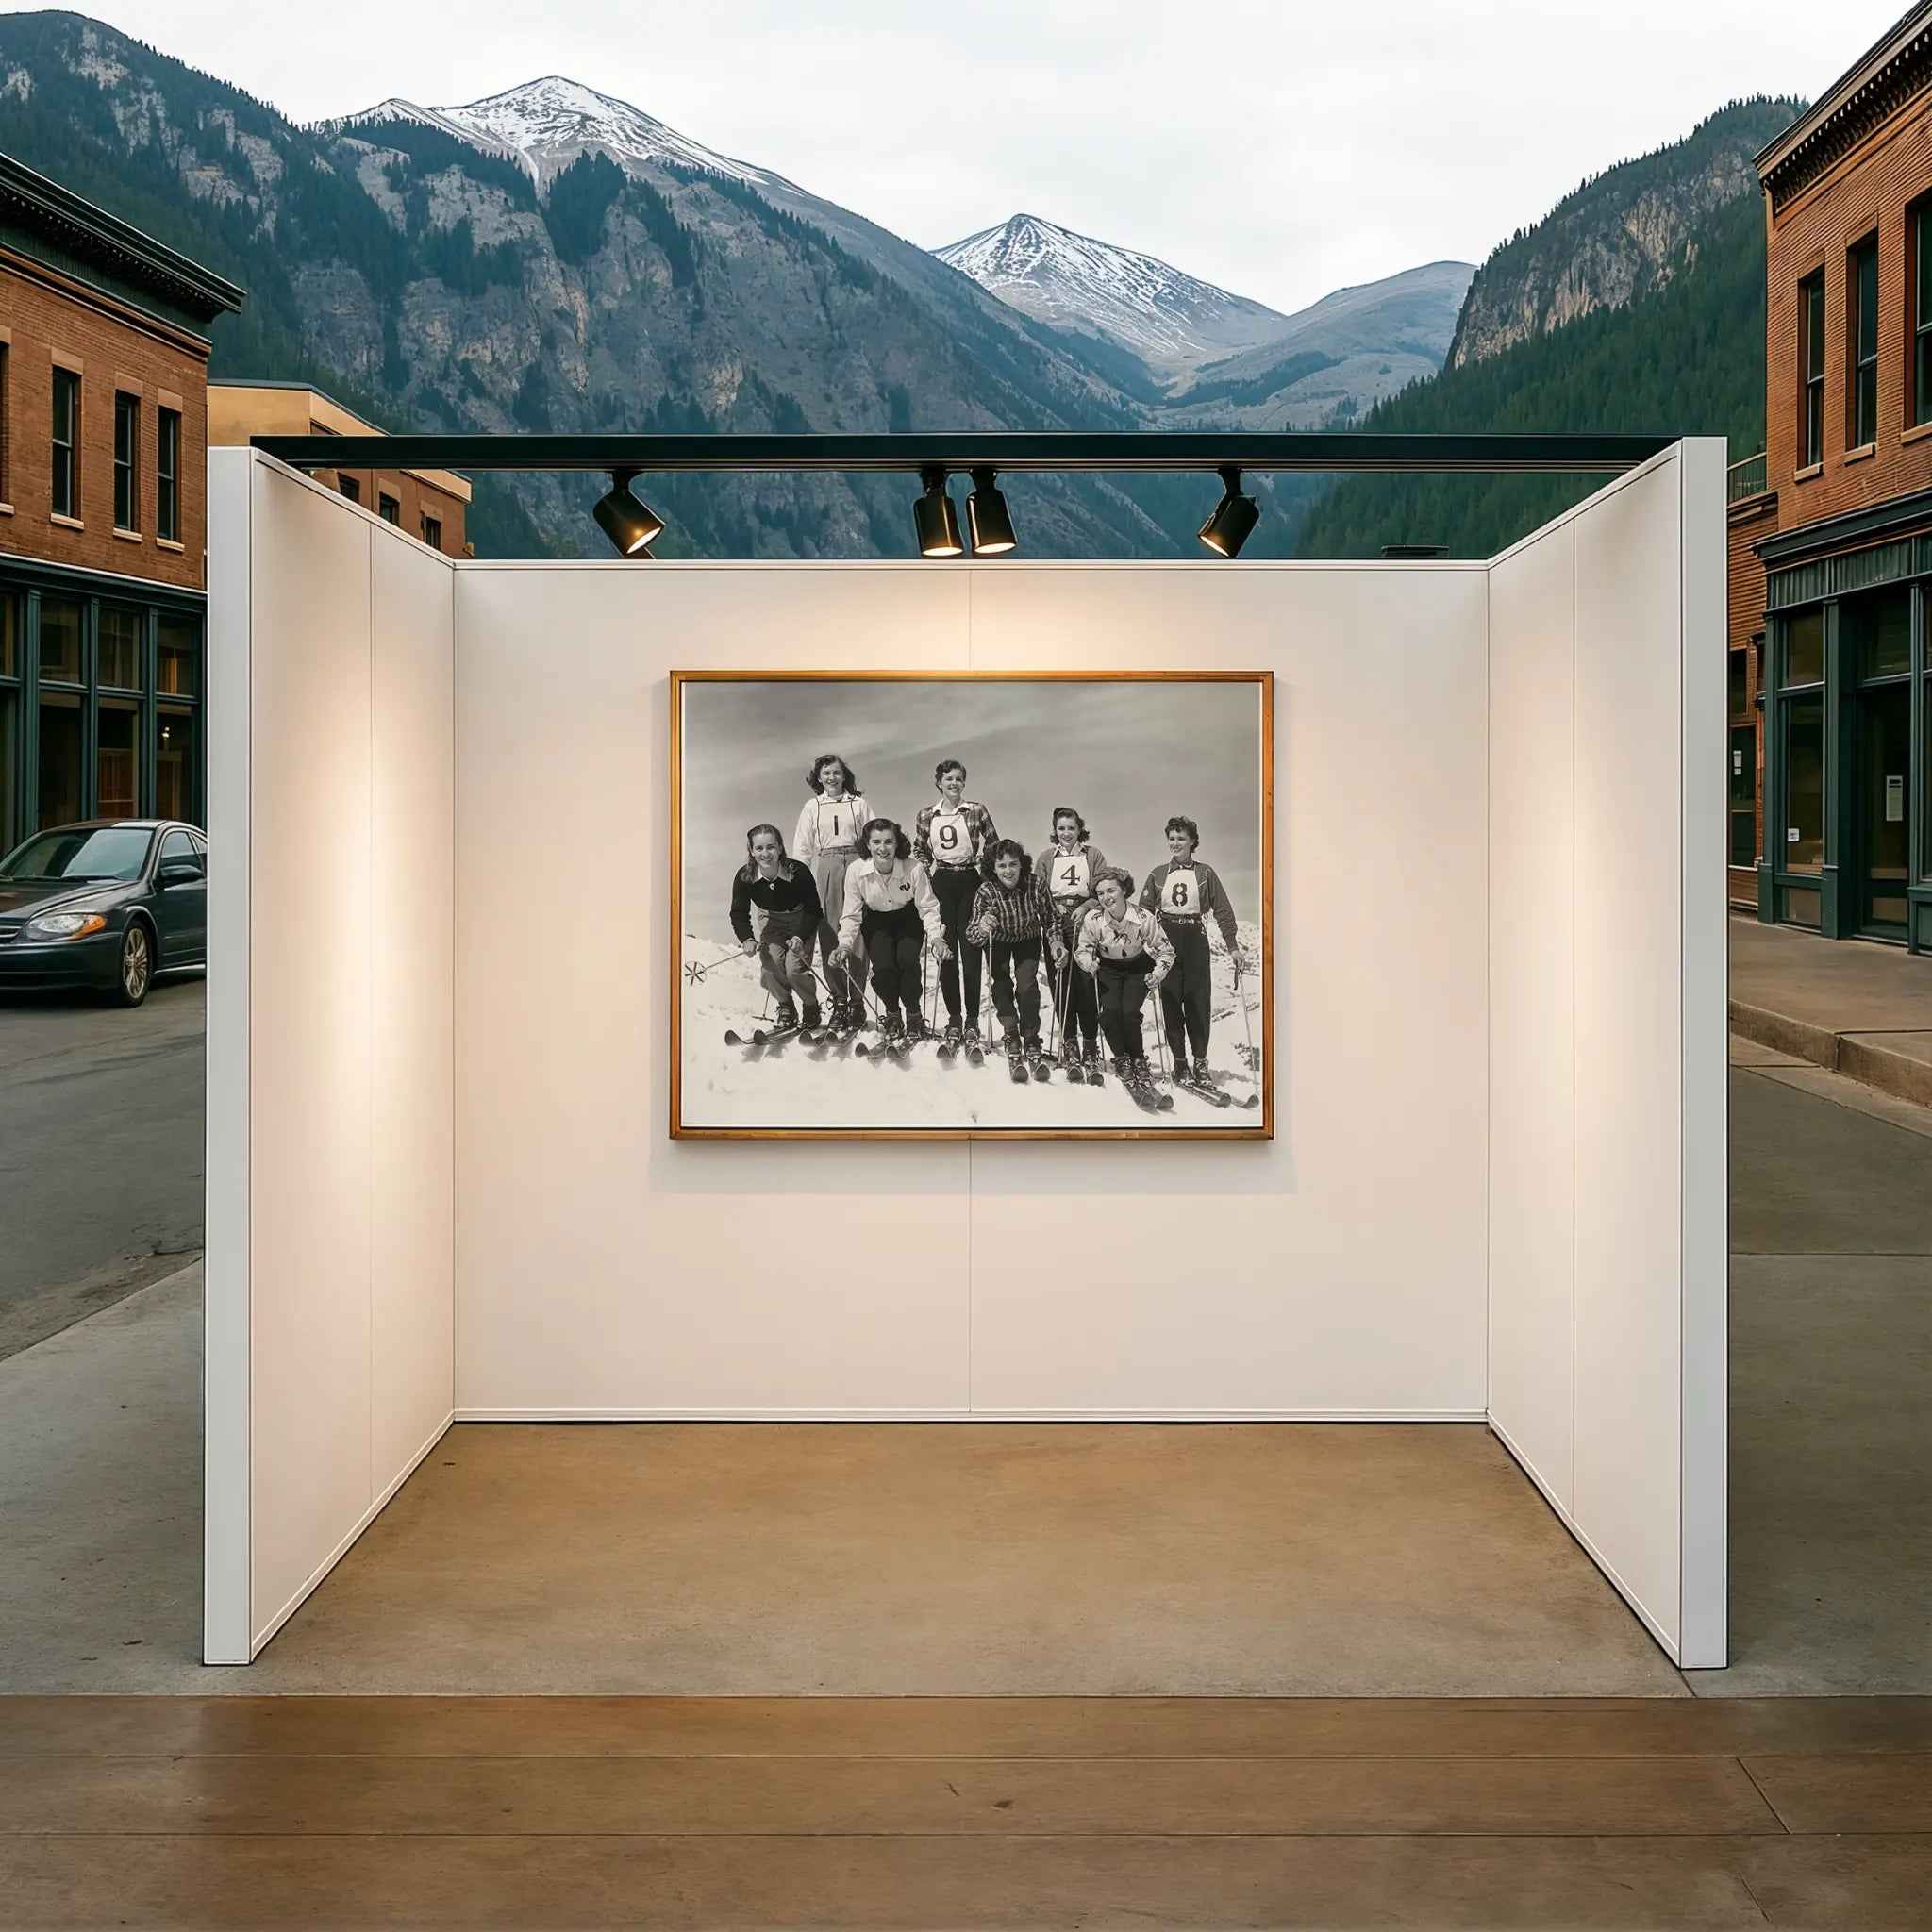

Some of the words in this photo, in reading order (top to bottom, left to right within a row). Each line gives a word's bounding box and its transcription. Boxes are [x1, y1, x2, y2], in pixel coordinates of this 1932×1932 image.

[939, 824, 958, 850] 9
[1060, 864, 1081, 886] 4
[1171, 882, 1188, 907] 8
